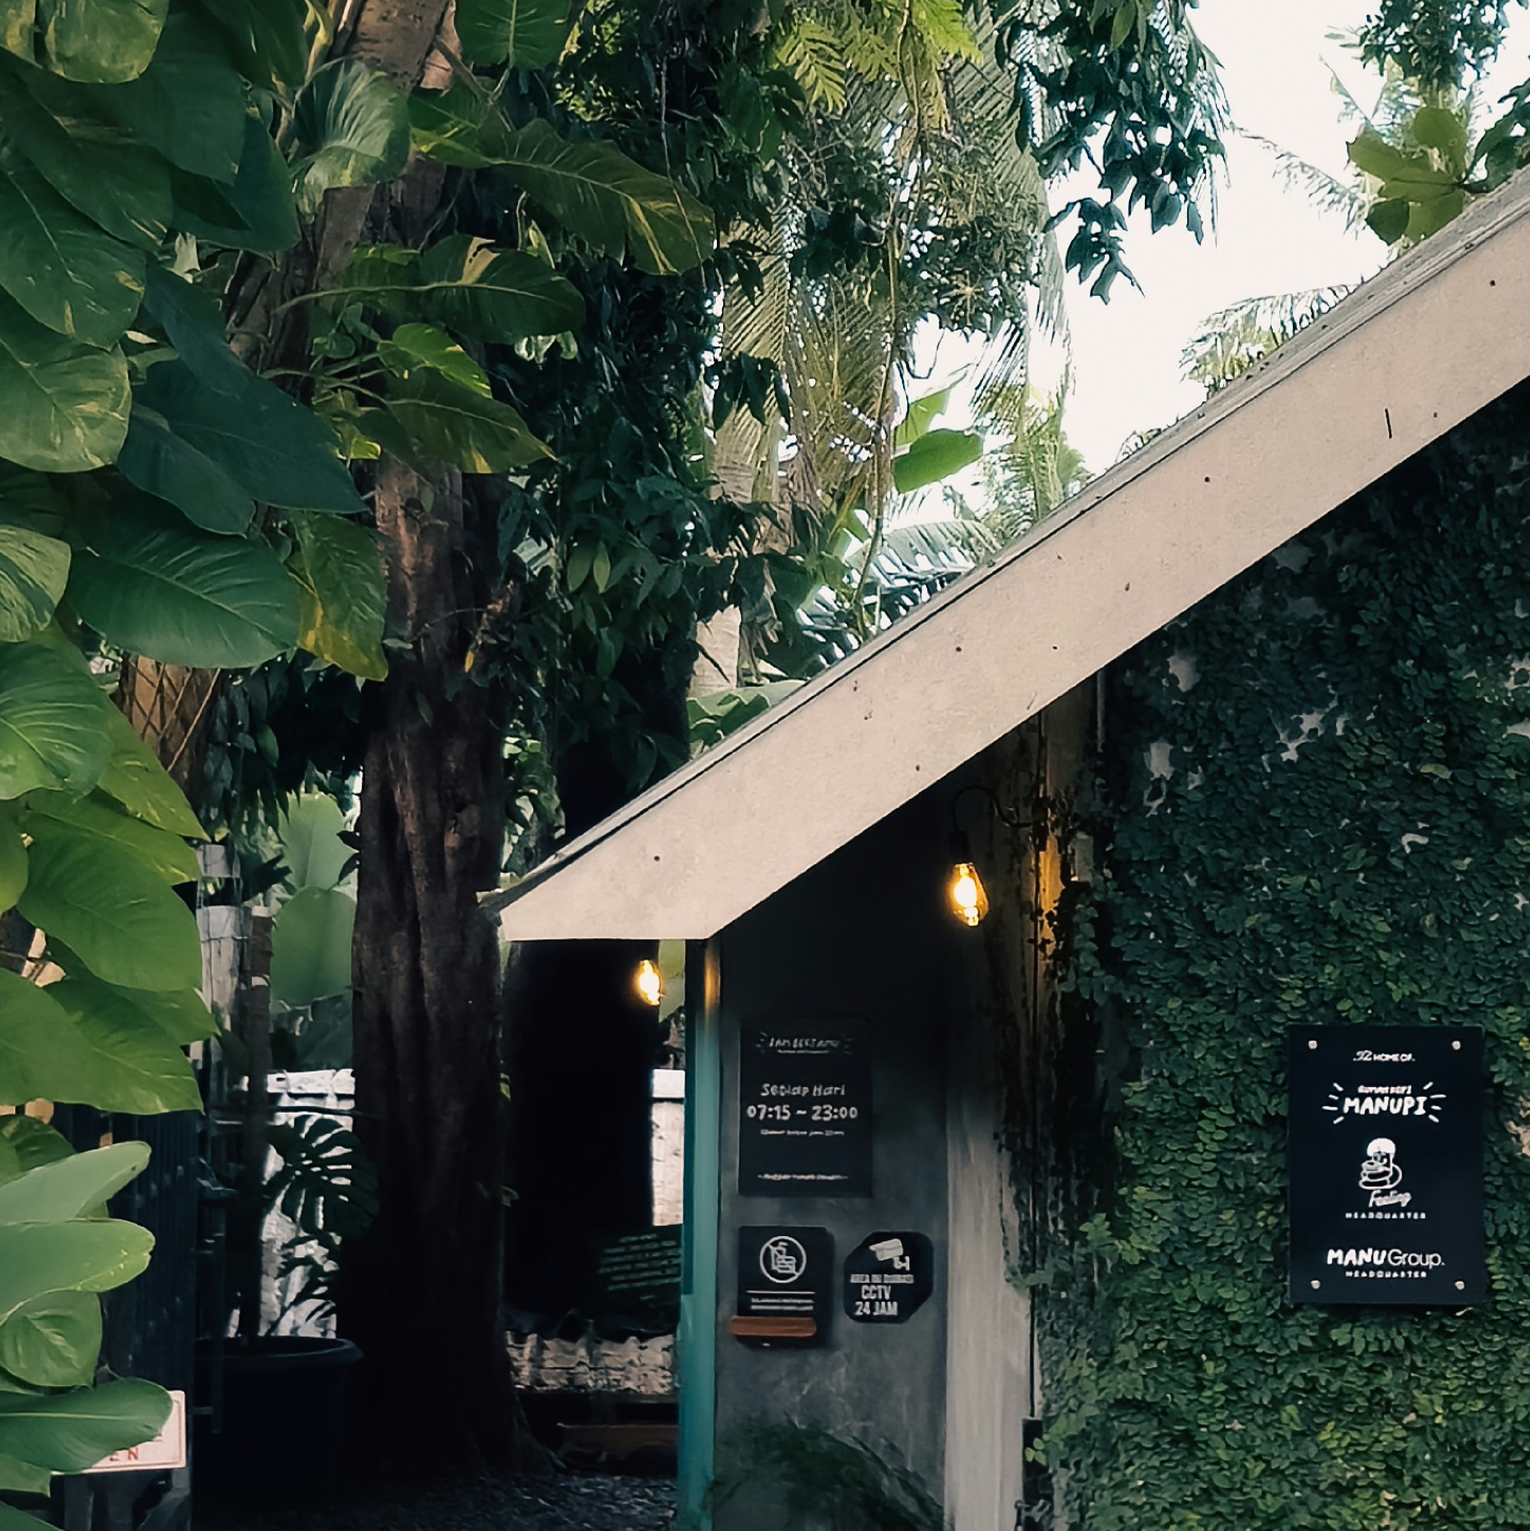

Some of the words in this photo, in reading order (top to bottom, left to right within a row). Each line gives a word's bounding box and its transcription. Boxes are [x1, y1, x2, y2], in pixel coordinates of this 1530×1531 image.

[812, 1084, 846, 1097] Hari
[746, 1104, 791, 1121] 07:15
[811, 1104, 858, 1121] 23:00
[1343, 1096, 1428, 1116] MANUPI
[861, 1285, 891, 1300] CCTV
[855, 1301, 871, 1316] 24
[873, 1301, 898, 1316] JAM
